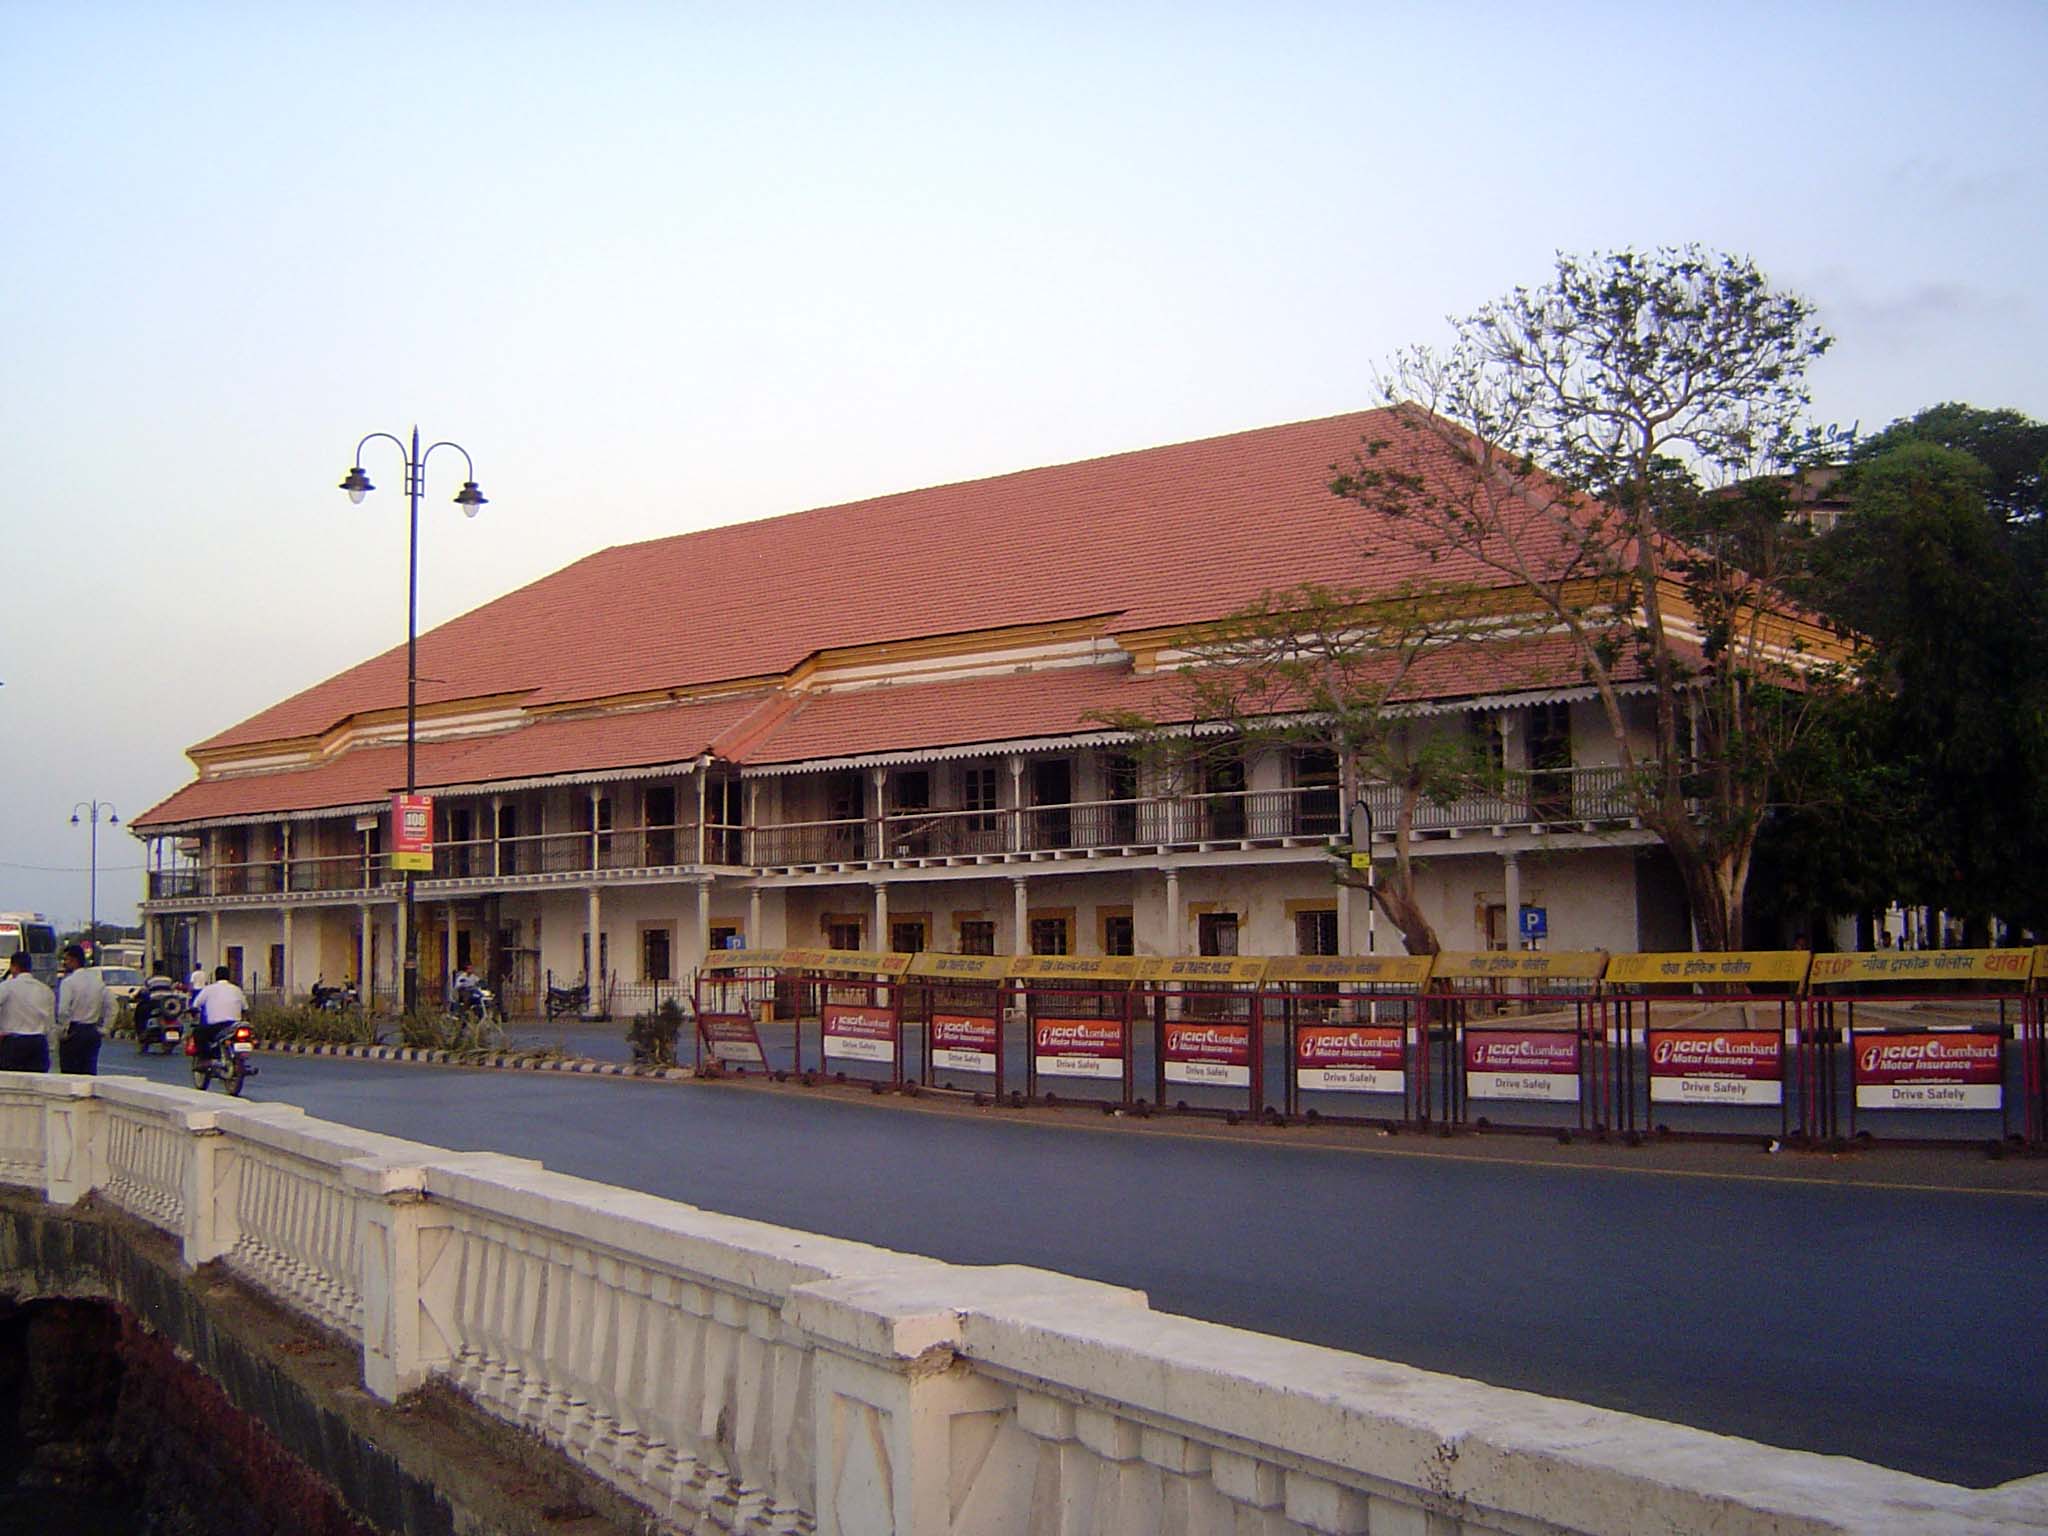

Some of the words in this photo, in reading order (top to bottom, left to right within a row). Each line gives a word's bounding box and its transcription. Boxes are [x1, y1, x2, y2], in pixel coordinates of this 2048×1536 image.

[1527, 913, 1539, 931] P
[1812, 957, 1853, 977] STOP
[1051, 1026, 1077, 1037] ICICI
[1181, 1031, 1206, 1043] ICICI
[1071, 1038, 1104, 1047] Insurance
[1180, 1041, 1199, 1051] Motor
[1201, 1043, 1232, 1053] Insurance
[1317, 1036, 1348, 1047] ICICI
[1360, 1036, 1400, 1048] Lombard
[1674, 1041, 1712, 1053] ICICI
[1725, 1041, 1777, 1055] Lombard
[1315, 1047, 1340, 1057] Motor
[1341, 1048, 1381, 1057] Insurance
[1488, 1044, 1519, 1055] ICICI
[1530, 1044, 1573, 1057] Lombard
[1883, 1046, 1924, 1058] ICICI
[1940, 1044, 1997, 1058] Lombard
[1078, 1060, 1099, 1070] Safely
[1486, 1055, 1510, 1064] Motor
[1511, 1056, 1549, 1065] Insurance
[1672, 1053, 1701, 1063] Motor
[1704, 1054, 1754, 1065] Insurance
[1880, 1060, 1914, 1070] Motor
[1916, 1060, 1971, 1070] Insurance
[1185, 1065, 1204, 1075] Drive
[1207, 1067, 1228, 1078] Safely
[1323, 1072, 1347, 1081] Drive
[1349, 1072, 1376, 1084] Safely
[1496, 1078, 1520, 1088] Drive
[1523, 1079, 1551, 1091] Safely
[1681, 1081, 1710, 1092] Drive
[1713, 1081, 1746, 1095] Safely
[1892, 1089, 1924, 1100] Drive
[1927, 1089, 1966, 1101] Safely
